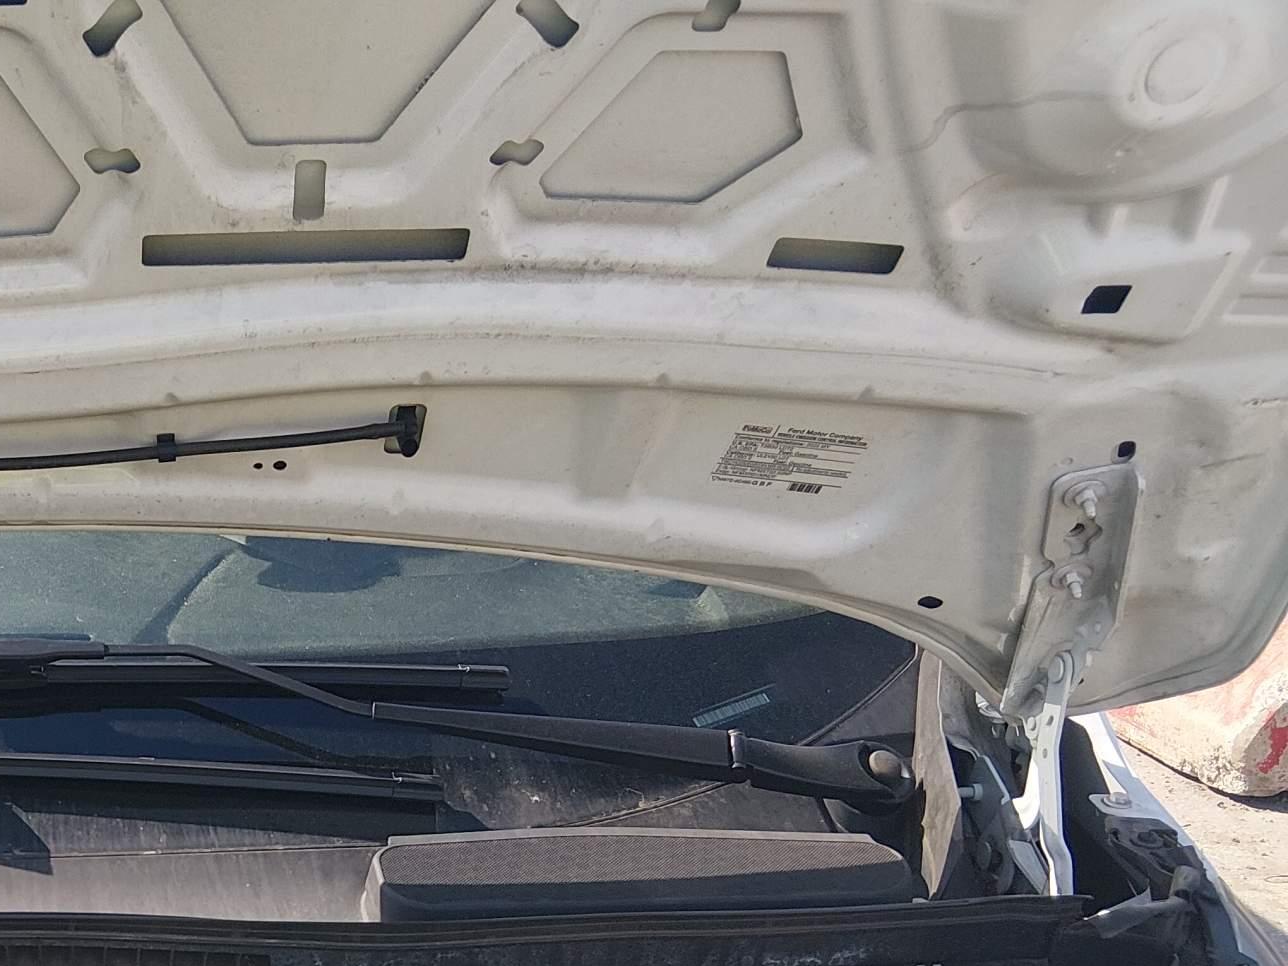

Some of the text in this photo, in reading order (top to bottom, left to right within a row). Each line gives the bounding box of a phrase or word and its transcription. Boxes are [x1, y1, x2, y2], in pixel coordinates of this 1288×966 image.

[787, 427, 864, 442] Ford Motor Company
